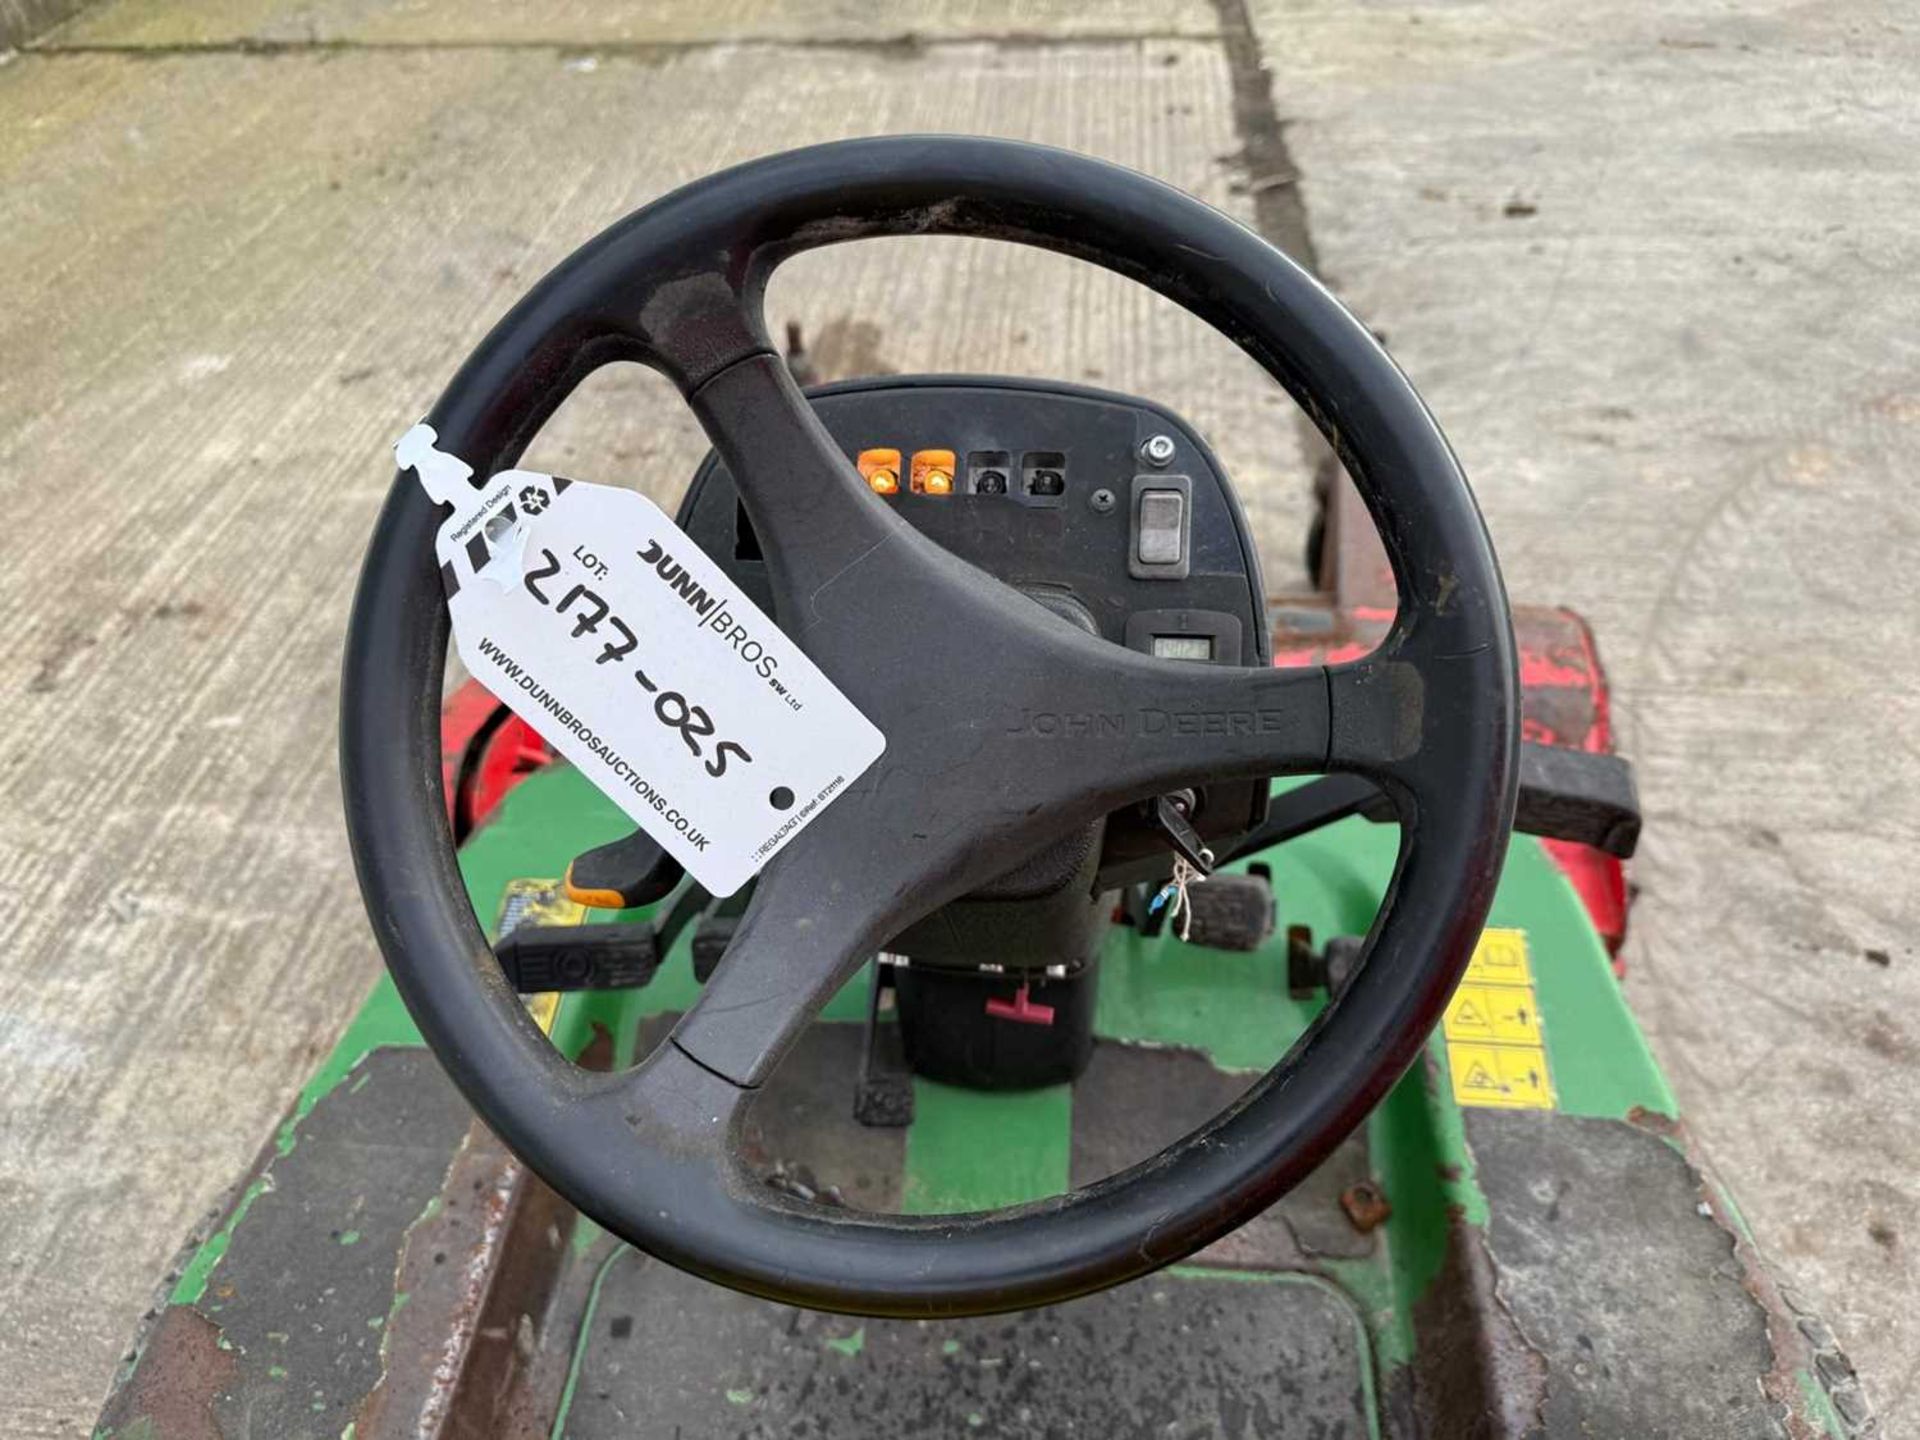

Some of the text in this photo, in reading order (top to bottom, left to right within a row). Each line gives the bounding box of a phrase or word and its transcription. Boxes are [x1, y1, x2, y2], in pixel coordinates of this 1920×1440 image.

[450, 484, 512, 541] Registered Design
[572, 545, 609, 581] LOT:
[524, 548, 752, 778] 2177-025
[784, 693, 803, 711] Ltd
[478, 637, 711, 852] WWW.DUNNBROSAUCTIONS.CO.UK
